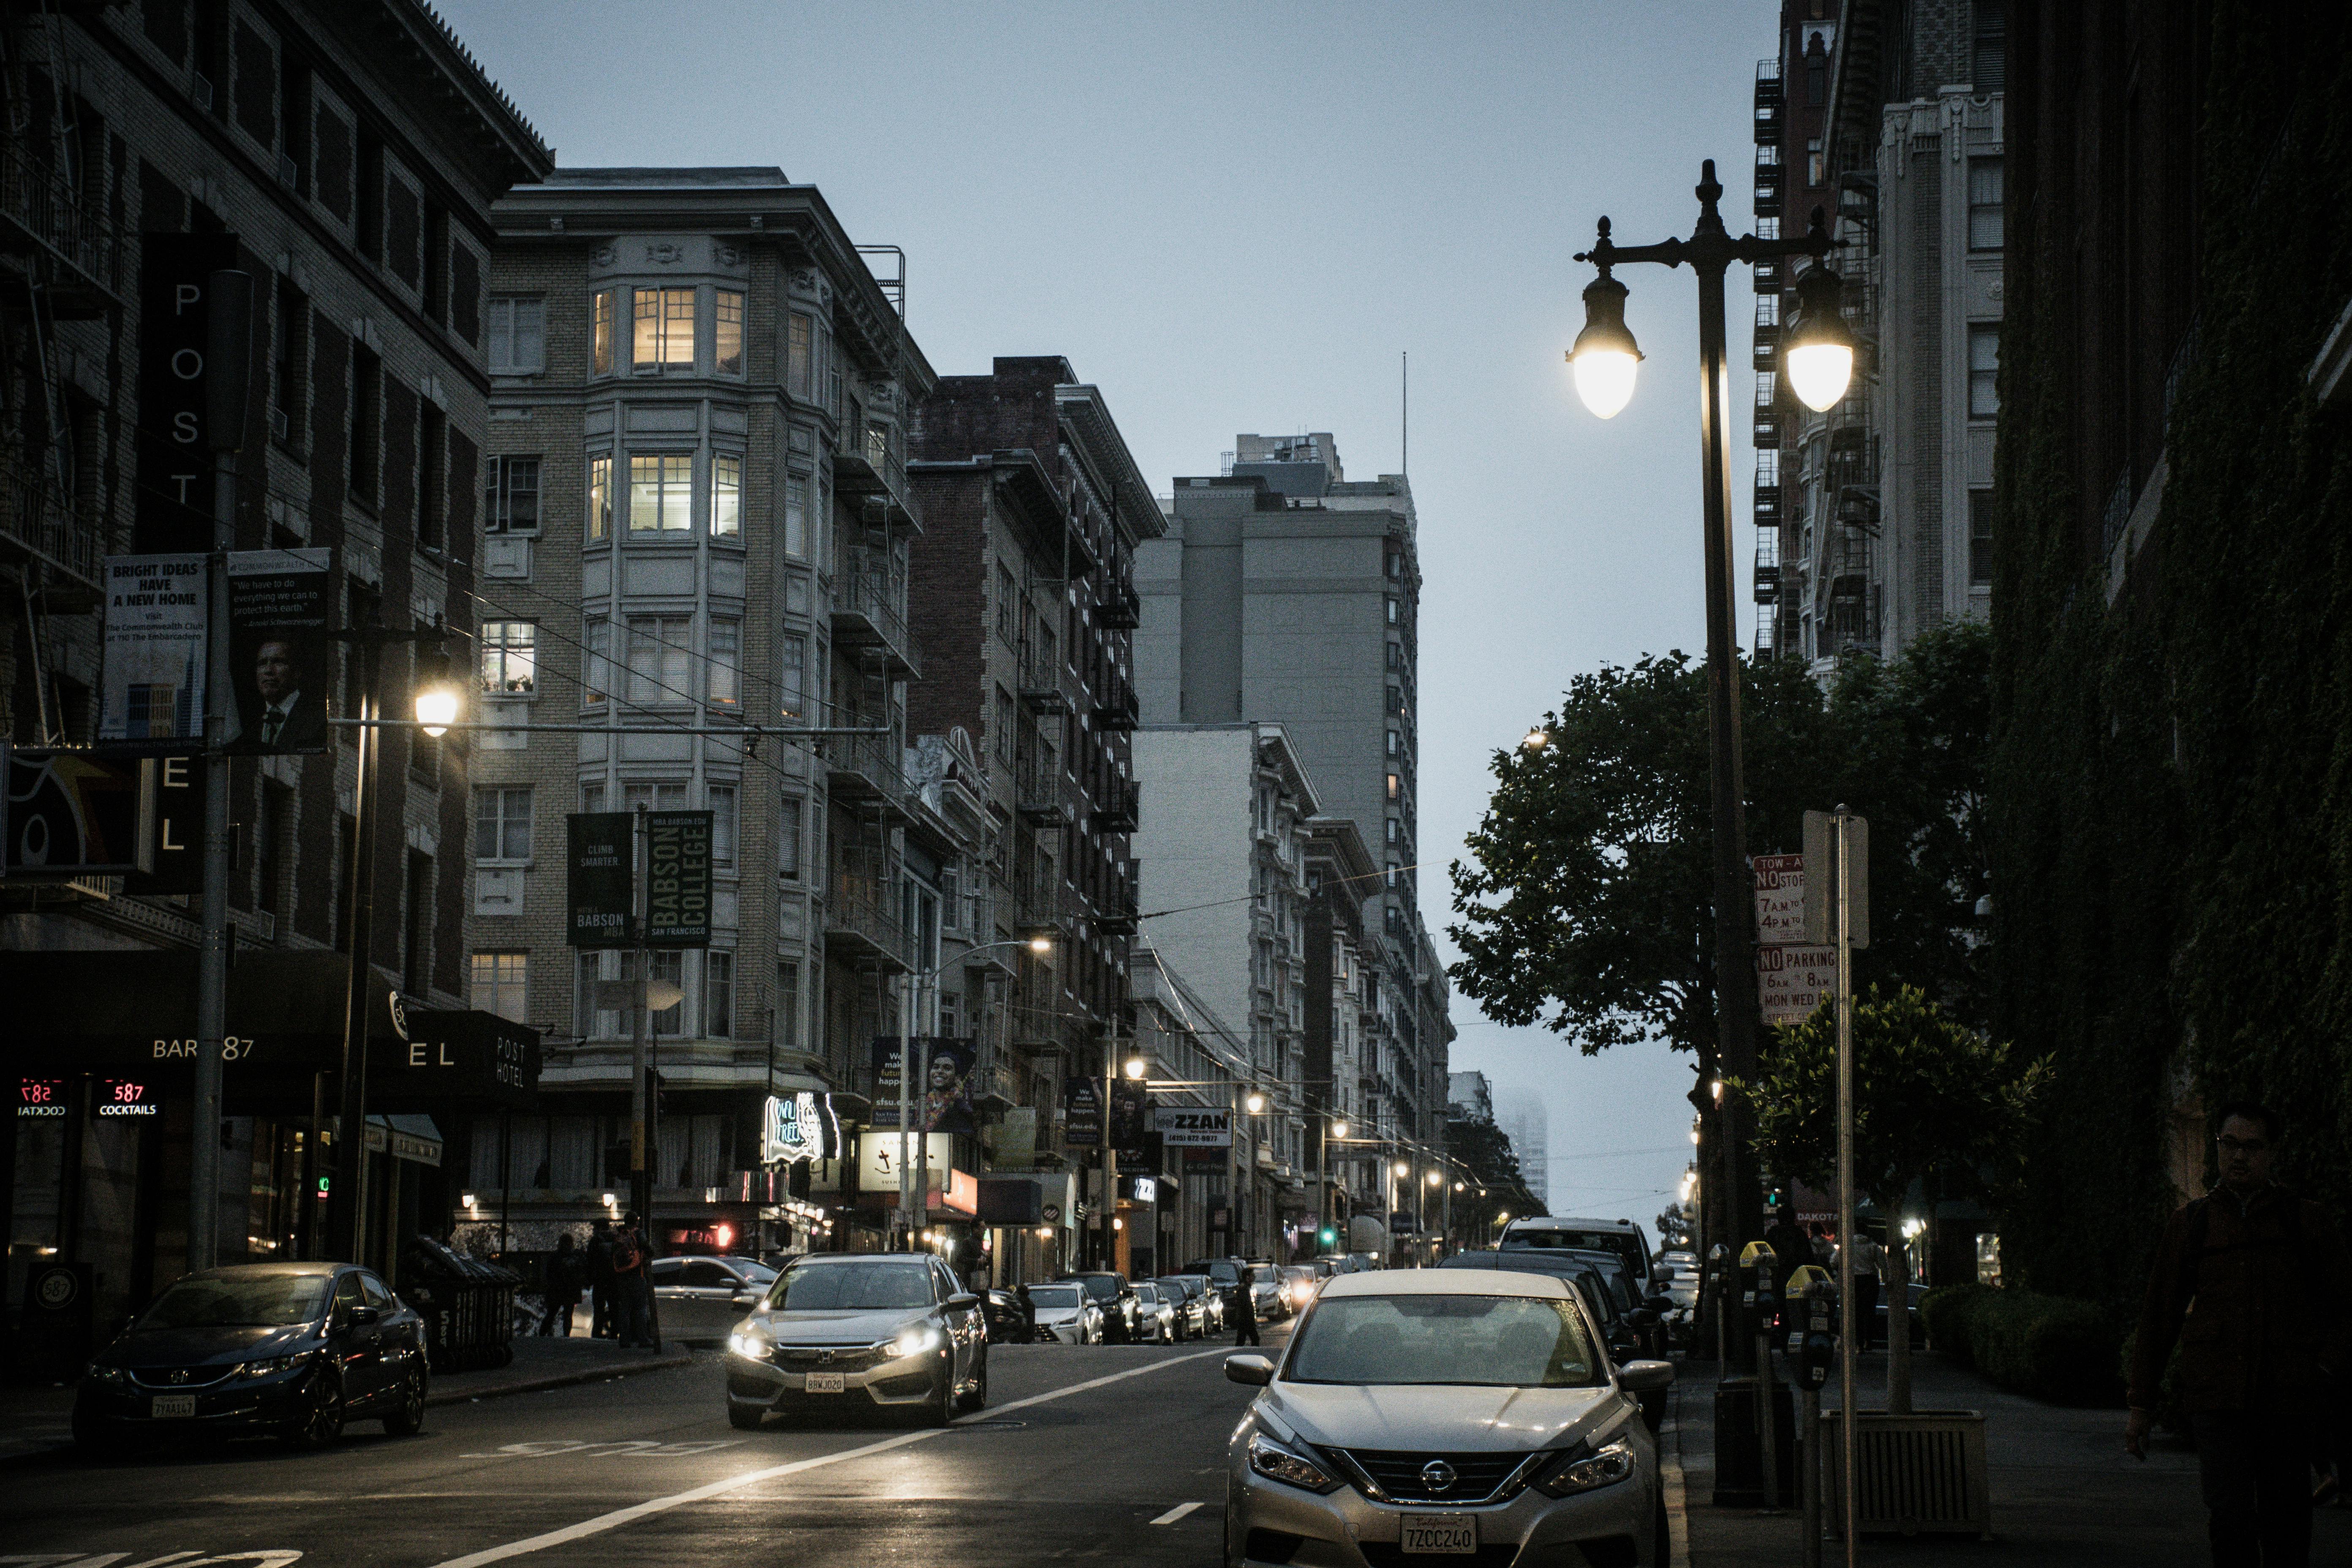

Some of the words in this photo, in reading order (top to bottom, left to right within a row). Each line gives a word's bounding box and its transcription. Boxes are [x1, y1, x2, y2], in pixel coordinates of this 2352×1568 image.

[171, 284, 204, 505] POST
[113, 564, 158, 577] BRIGHT
[162, 563, 198, 576] IDEAS
[139, 579, 171, 591] HAVE
[252, 580, 272, 589] have
[283, 579, 295, 587] do
[113, 595, 122, 607] A
[127, 594, 155, 606] NEW
[159, 593, 196, 605] HOME
[234, 593, 276, 604] everything
[234, 606, 262, 616] protect
[122, 622, 182, 631] Commonwealth
[148, 632, 201, 640] Embarcadero
[588, 845, 614, 854] CLIMB
[653, 827, 680, 927] BABSON
[681, 826, 707, 926] COLLEGE
[1757, 870, 1778, 887] NO
[577, 913, 624, 927] BABSON
[603, 926, 625, 937] MBA
[667, 927, 706, 935] FRANCISCO
[1761, 950, 1781, 970] NO
[1786, 951, 1835, 968] PARKING
[1764, 994, 1788, 1007] MON
[1791, 994, 1814, 1006] WED
[152, 1039, 198, 1058] BAR
[497, 1036, 525, 1064] POST
[496, 1061, 524, 1089] HOTEL
[114, 1083, 144, 1102] 587
[99, 1104, 156, 1116] COCKTAILS
[1175, 1114, 1228, 1129] ZZAN
[1406, 1530, 1472, 1548] 7ZCC240
